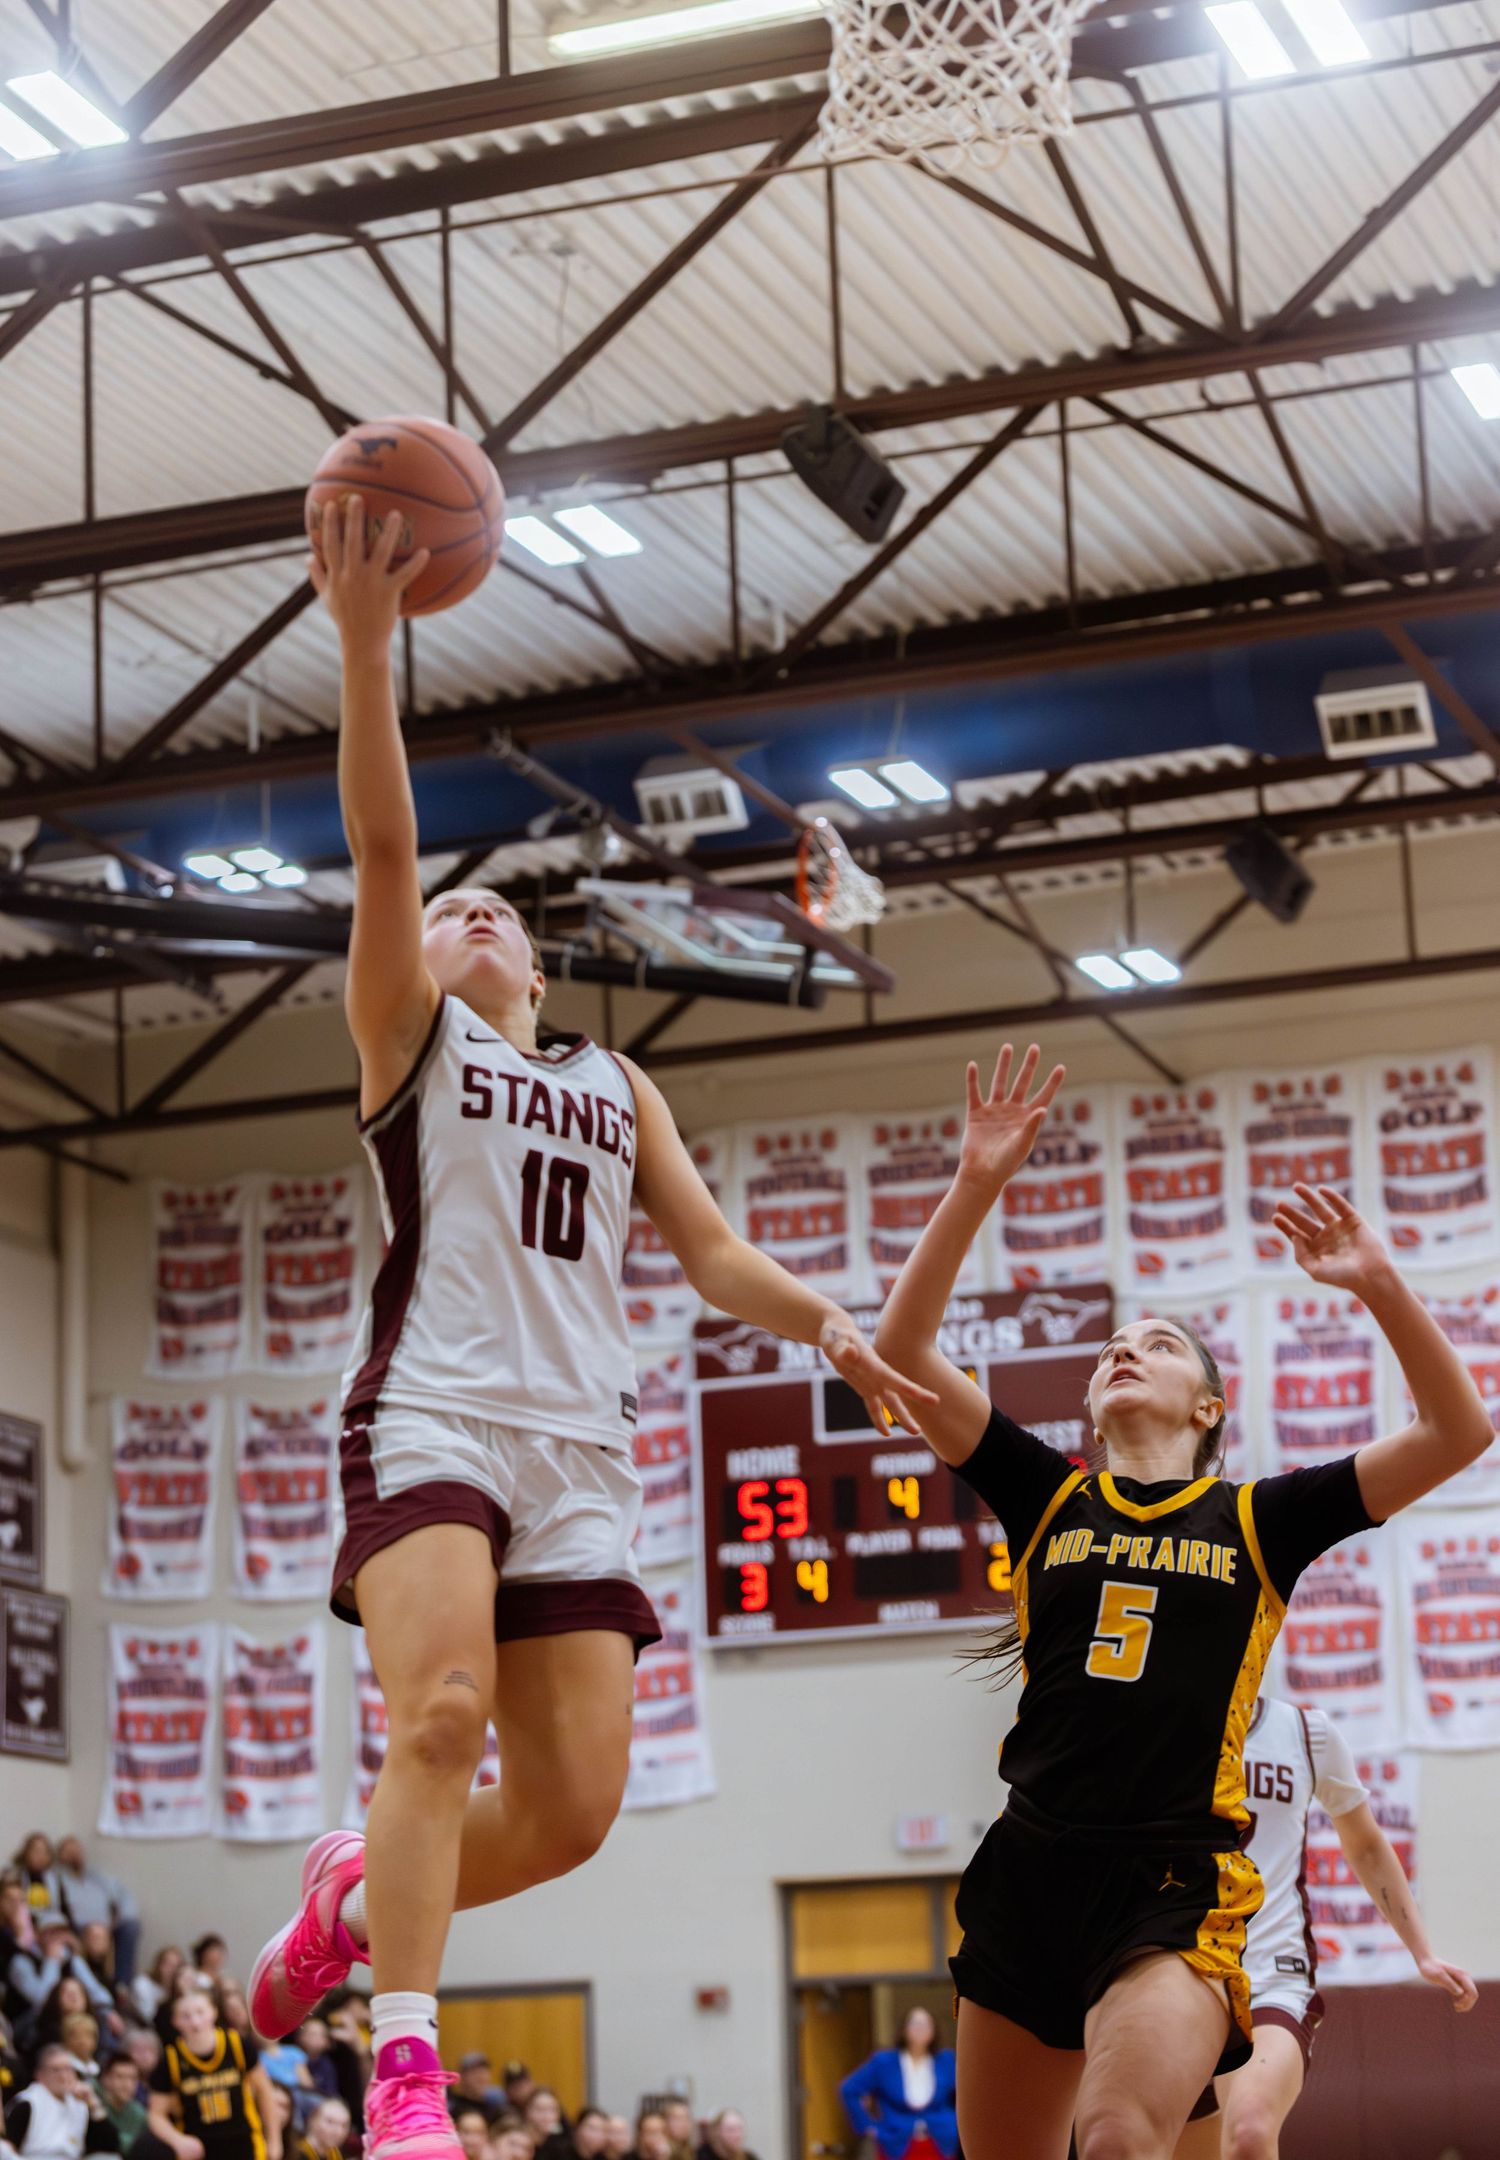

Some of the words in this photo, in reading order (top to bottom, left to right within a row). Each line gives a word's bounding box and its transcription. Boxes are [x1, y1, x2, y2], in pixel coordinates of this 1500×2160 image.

[461, 1064, 634, 1169] STANGS
[1027, 1144, 1100, 1168] OLF
[521, 1149, 590, 1262] 10
[727, 1447, 799, 1479] HOME
[737, 1478, 808, 1541] 53
[888, 1476, 920, 1519] 4
[796, 1560, 829, 1603] 4
[1044, 1528, 1237, 1585] MID-PRAIRIE
[740, 1562, 768, 1612] 3
[1085, 1580, 1159, 1682] 5
